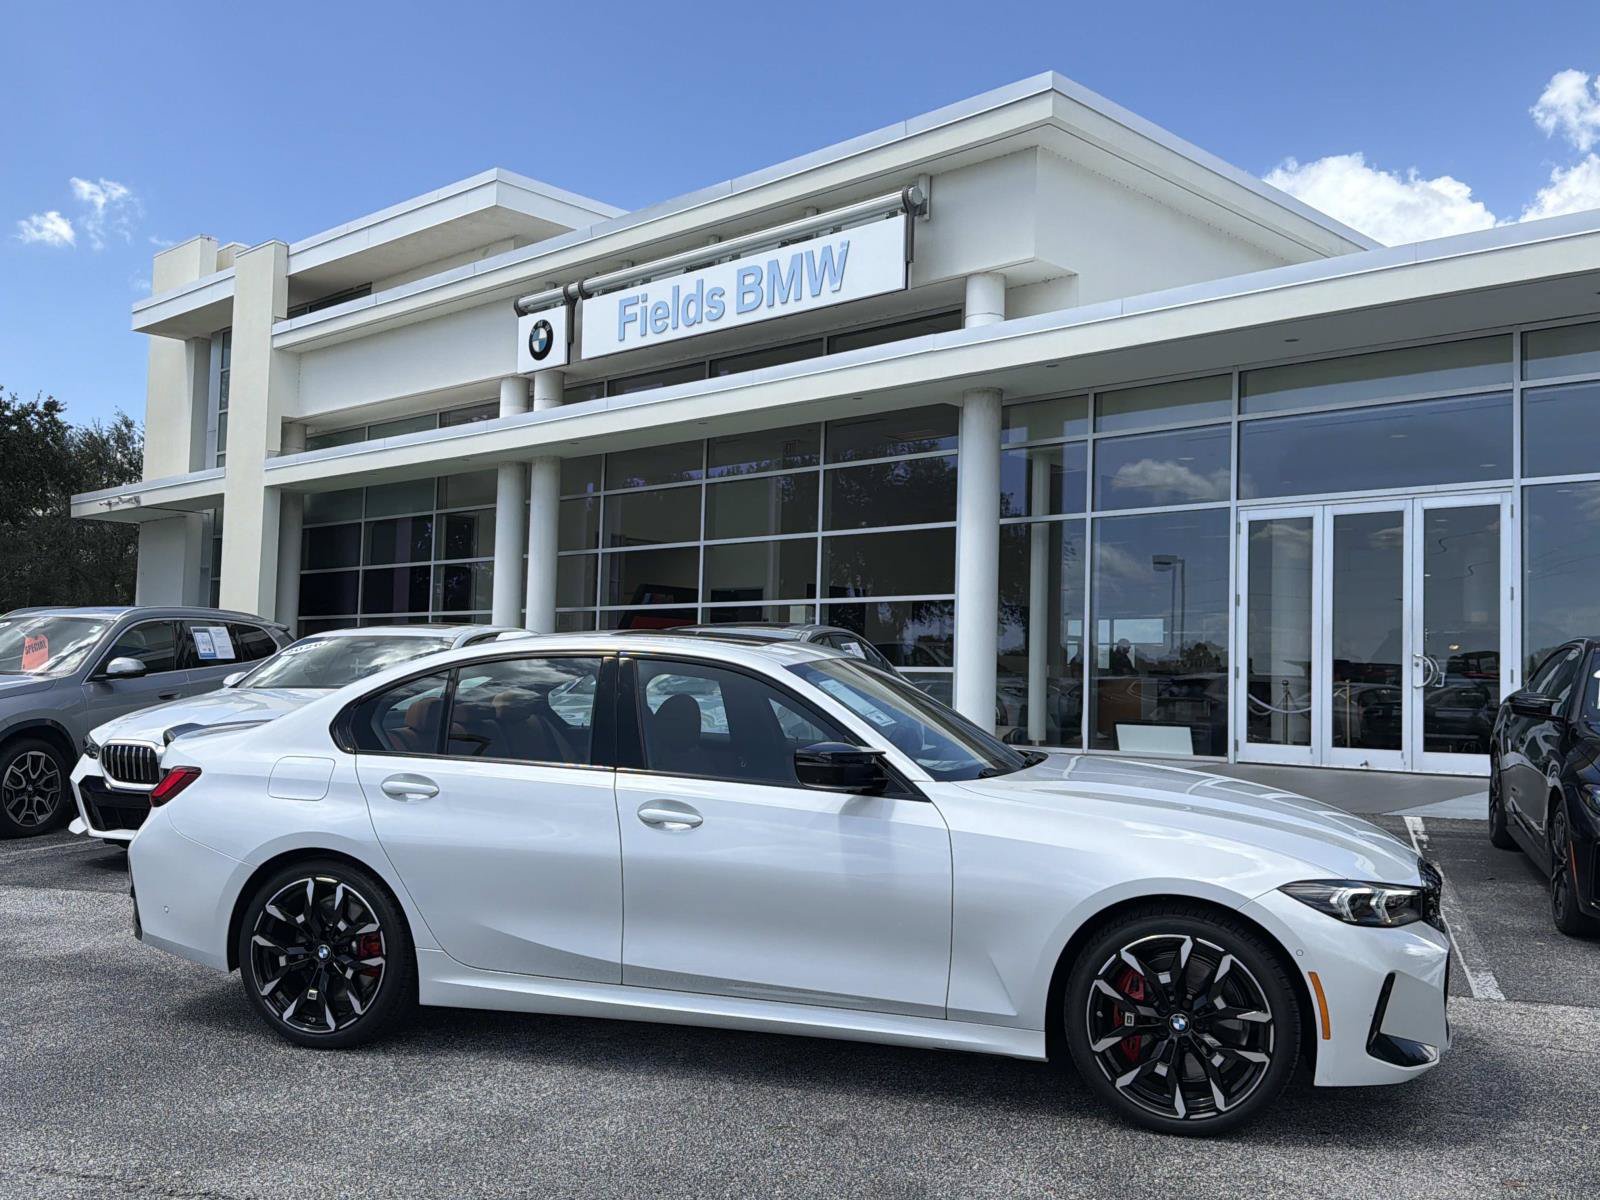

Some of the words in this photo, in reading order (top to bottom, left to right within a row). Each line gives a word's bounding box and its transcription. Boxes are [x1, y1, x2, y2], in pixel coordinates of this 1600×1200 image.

[617, 278, 726, 342] Fields
[736, 240, 851, 315] BMW
[25, 639, 48, 655] SPECIAL
